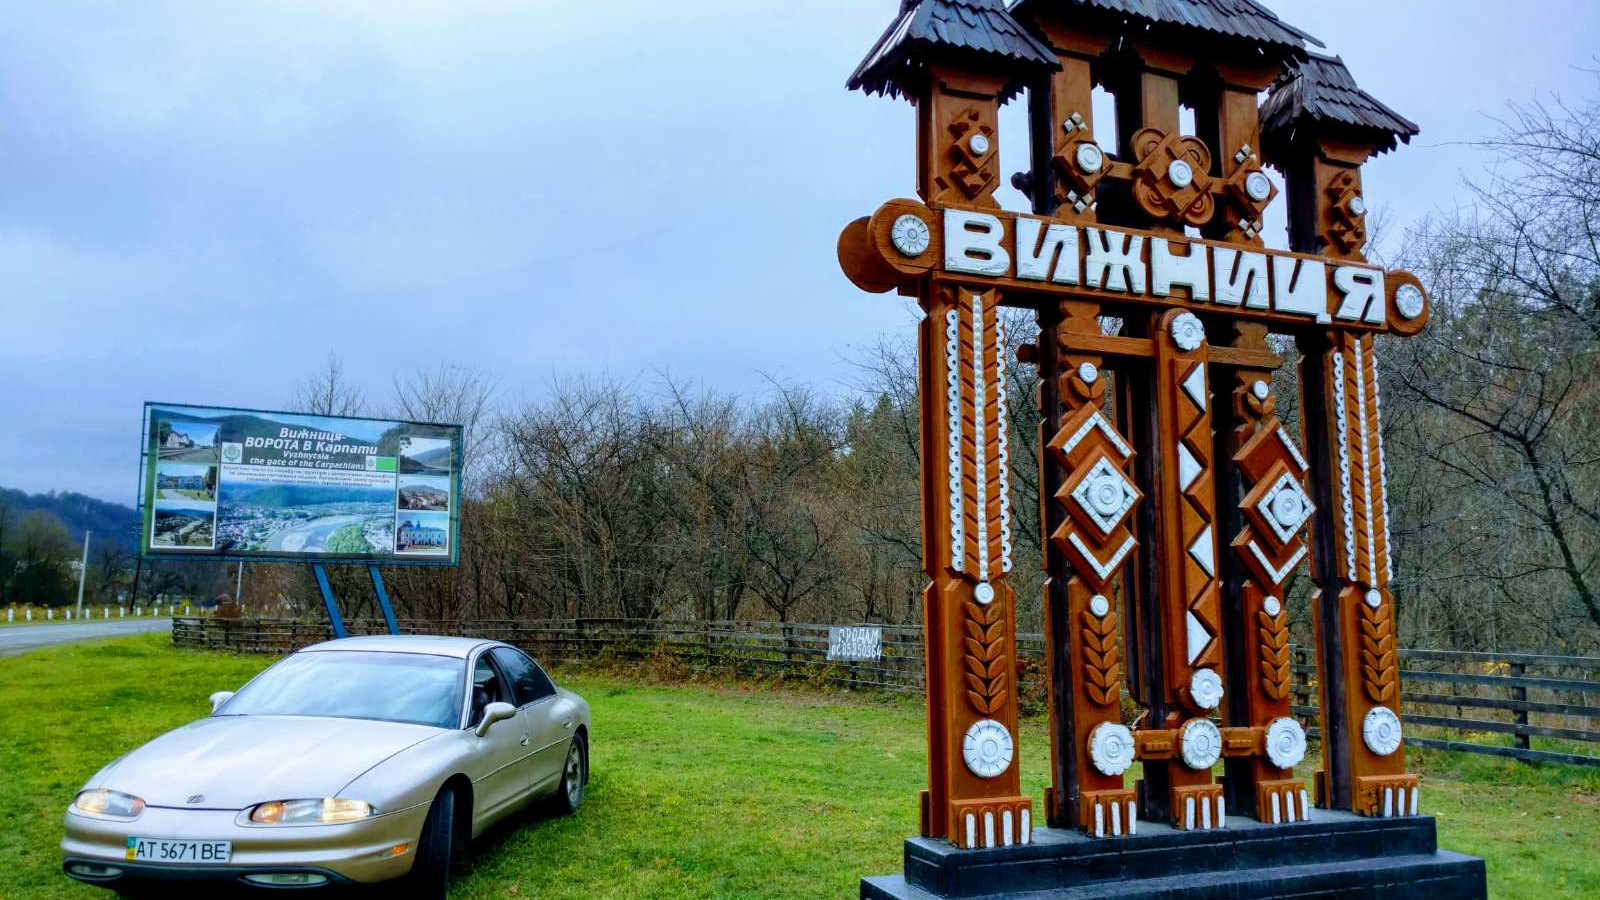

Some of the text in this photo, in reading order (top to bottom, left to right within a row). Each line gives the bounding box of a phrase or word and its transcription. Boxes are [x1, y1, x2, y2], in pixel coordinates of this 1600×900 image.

[943, 207, 1386, 325] ВИЖНИЦЯ
[244, 436, 300, 451] ВОРОТА
[315, 441, 378, 455] Карпати
[249, 457, 366, 471] the gate of the Carpathians
[136, 841, 227, 860] AT 5671 BE
